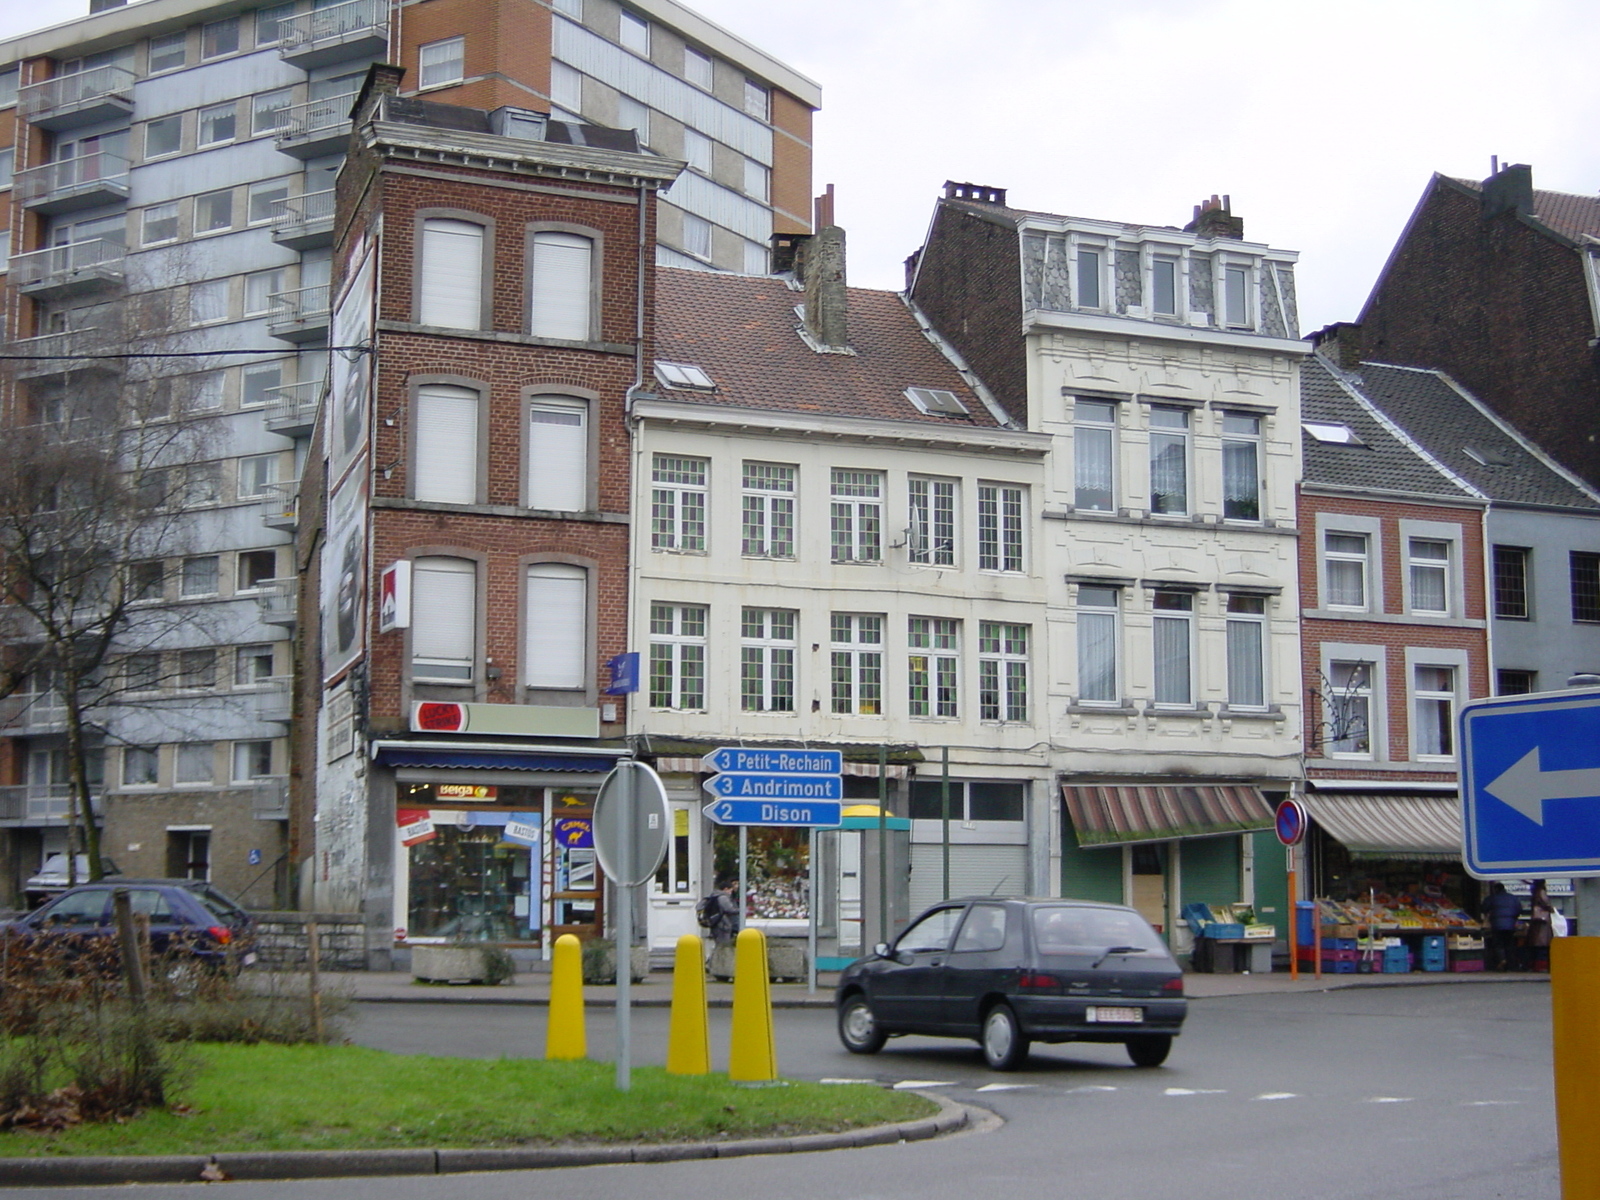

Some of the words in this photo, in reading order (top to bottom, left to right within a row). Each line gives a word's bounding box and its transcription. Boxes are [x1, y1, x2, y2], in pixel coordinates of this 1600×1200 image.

[423, 704, 456, 719] LUCKY
[423, 713, 460, 730] STRIKE
[721, 752, 731, 769] 3
[737, 753, 832, 771] Petit-Rechain
[440, 785, 473, 797] Belga
[722, 777, 733, 794] 3
[741, 778, 832, 796] Andrimont
[721, 803, 733, 820] 2
[761, 804, 811, 821] Dison
[513, 825, 536, 839] BASTOS
[561, 820, 590, 832] CAMEL
